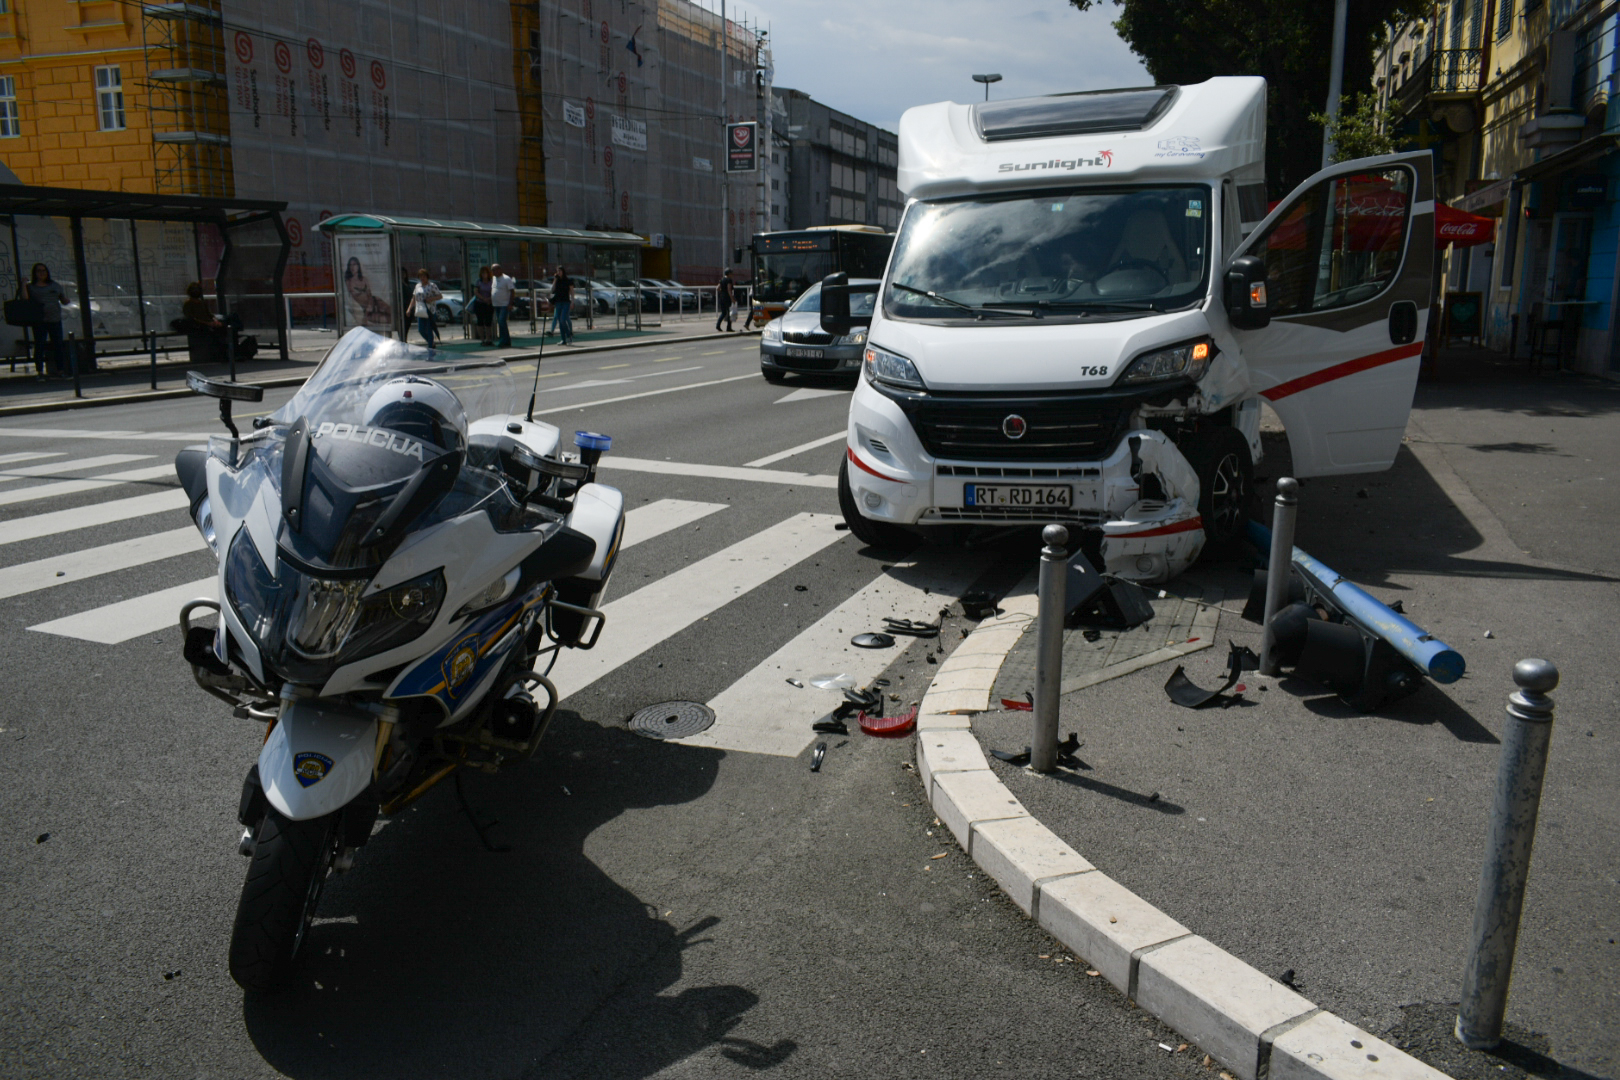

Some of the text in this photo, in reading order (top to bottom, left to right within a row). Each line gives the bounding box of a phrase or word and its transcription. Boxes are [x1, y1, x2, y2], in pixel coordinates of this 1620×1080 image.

[998, 157, 1103, 173] Sunlight
[1081, 365, 1108, 376] T68
[315, 422, 424, 462] POLICIJA
[976, 488, 998, 504] RT
